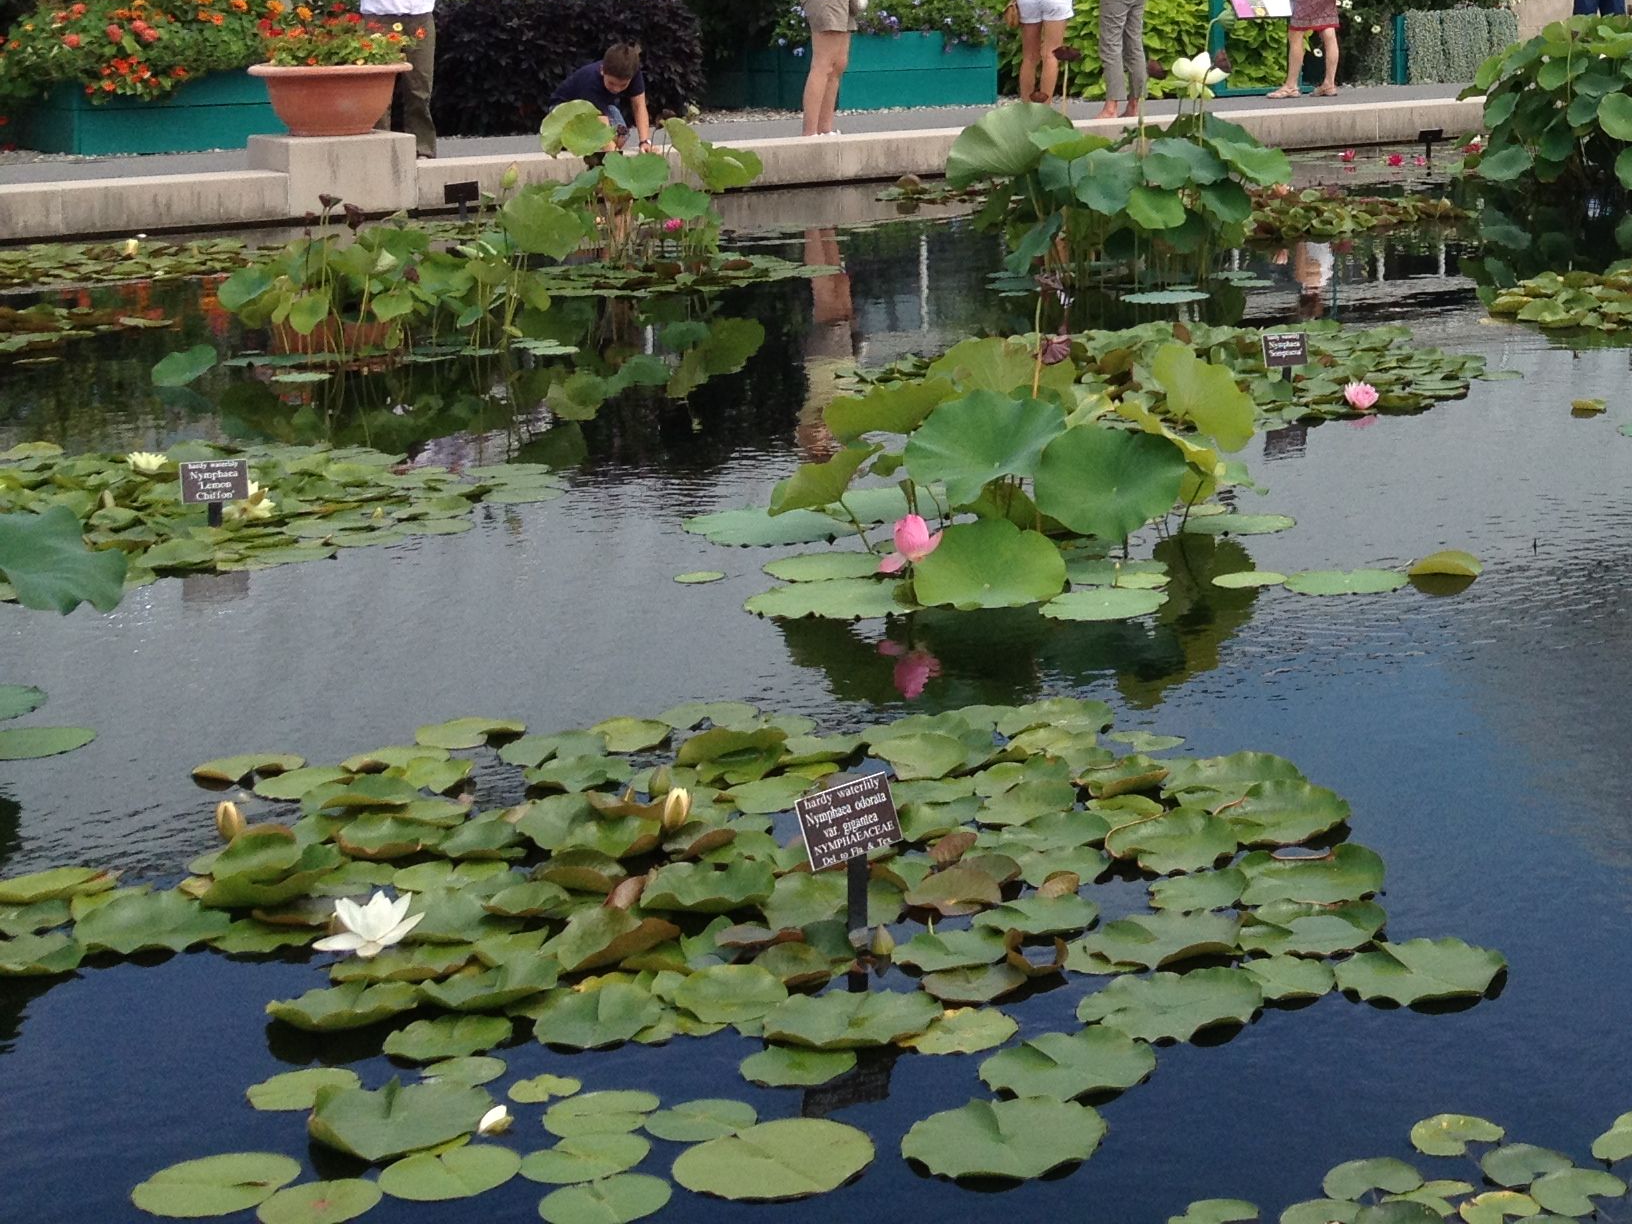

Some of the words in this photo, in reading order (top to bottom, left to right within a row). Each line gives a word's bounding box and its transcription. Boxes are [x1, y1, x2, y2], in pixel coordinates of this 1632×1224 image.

[189, 470, 239, 481] Nymphaea
[803, 792, 833, 810] hardy
[837, 777, 880, 798] waterlily
[805, 804, 852, 828] Nymphaea
[855, 792, 887, 811] odorata
[813, 820, 895, 856] NYMPHAEACEAE
[842, 812, 879, 836] gigantea
